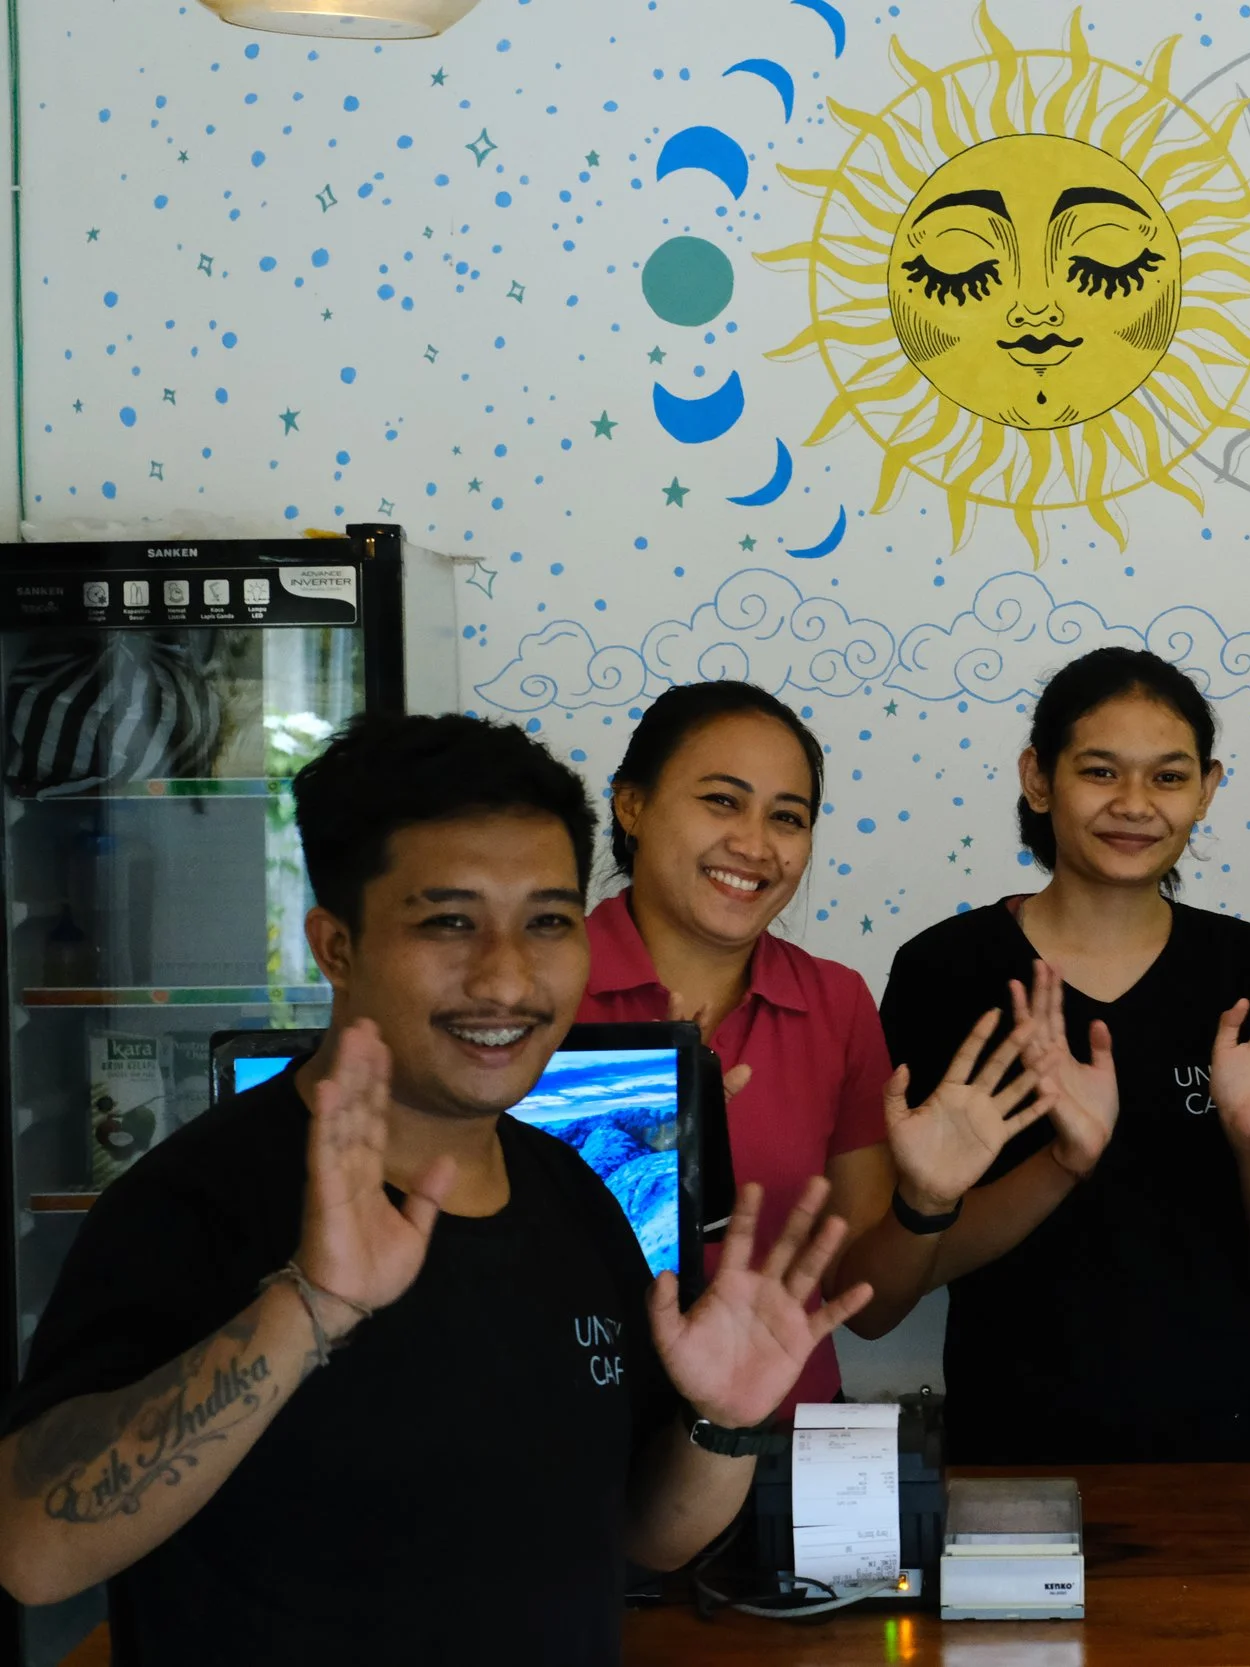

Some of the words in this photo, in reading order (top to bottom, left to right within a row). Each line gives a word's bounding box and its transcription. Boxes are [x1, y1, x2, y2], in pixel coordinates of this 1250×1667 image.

[147, 548, 198, 558] SANKEN
[290, 578, 352, 586] INVERTER
[112, 1039, 153, 1059] kara
[1185, 1092, 1217, 1114] CA
[590, 1355, 624, 1385] CAF
